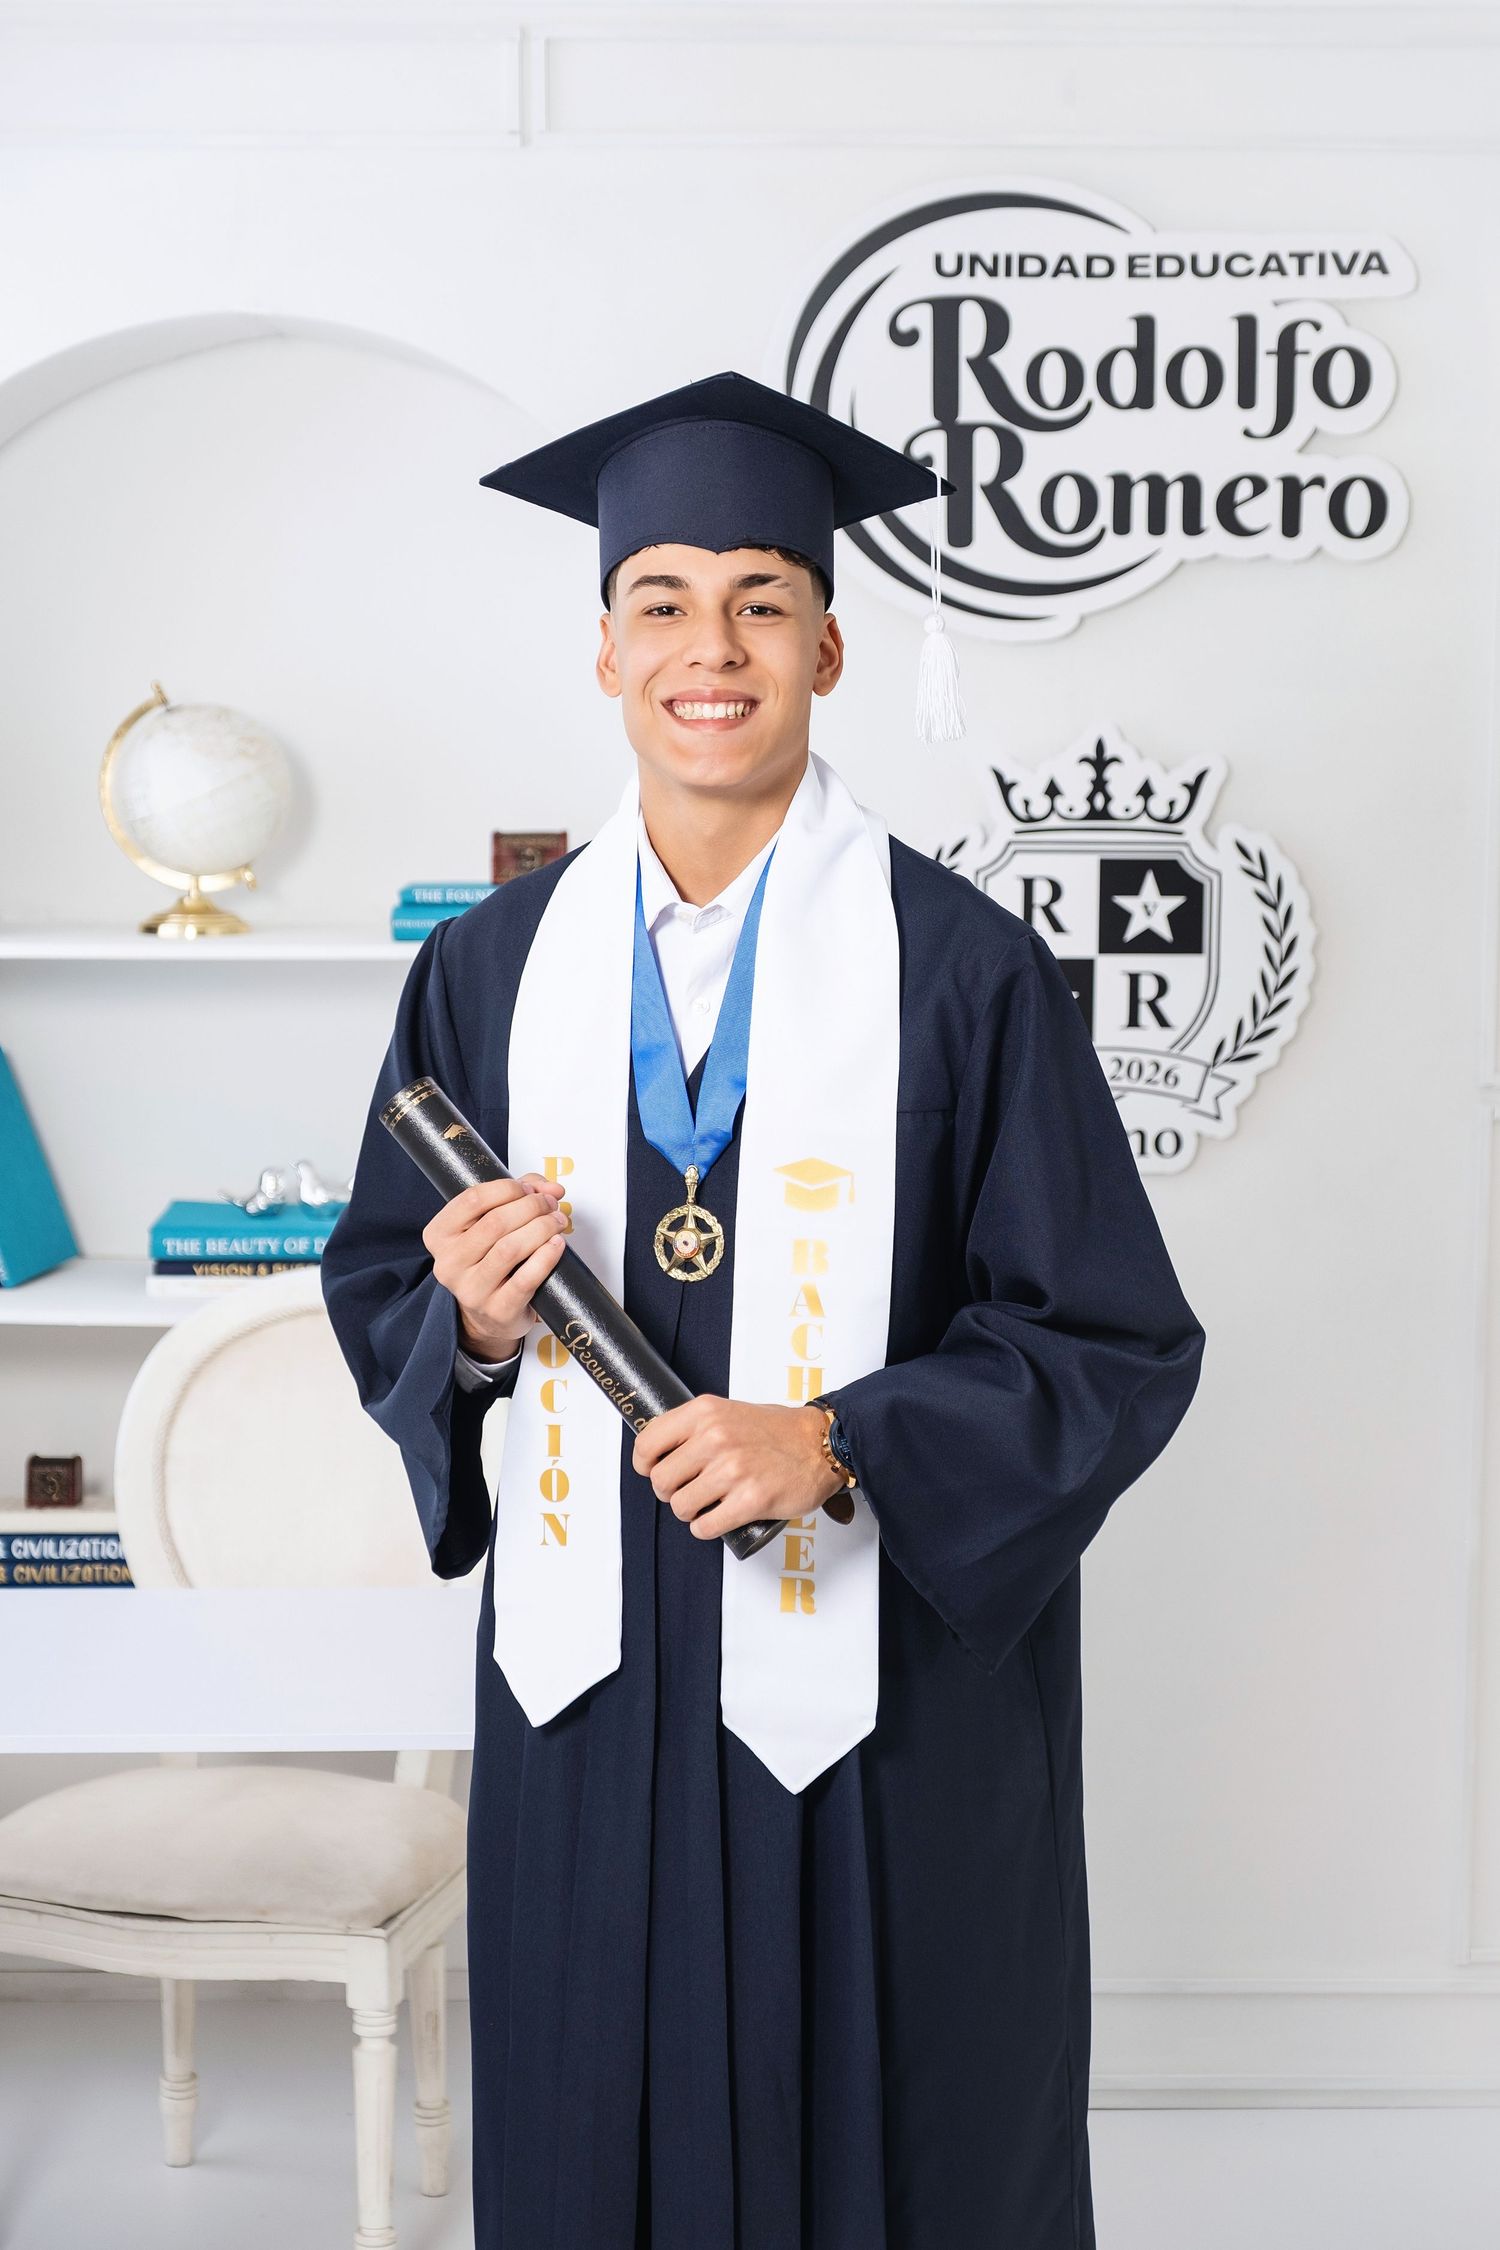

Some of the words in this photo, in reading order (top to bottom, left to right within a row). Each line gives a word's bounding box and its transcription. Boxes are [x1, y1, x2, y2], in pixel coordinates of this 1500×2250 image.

[933, 252, 1115, 279] UNIDAD
[1127, 250, 1390, 279] EDUCATIVA
[888, 296, 1372, 439] Rodolfo
[903, 422, 1389, 558] Romero
[412, 887, 441, 904] THE
[1018, 874, 1071, 936] R
[1120, 970, 1175, 1031] R
[1109, 1056, 1181, 1090] 2026
[162, 1236, 200, 1256] THE
[205, 1236, 280, 1256] BEAUTY
[283, 1236, 309, 1255] OF
[192, 1263, 252, 1277] VISION
[560, 1318, 637, 1417] Recuerdo
